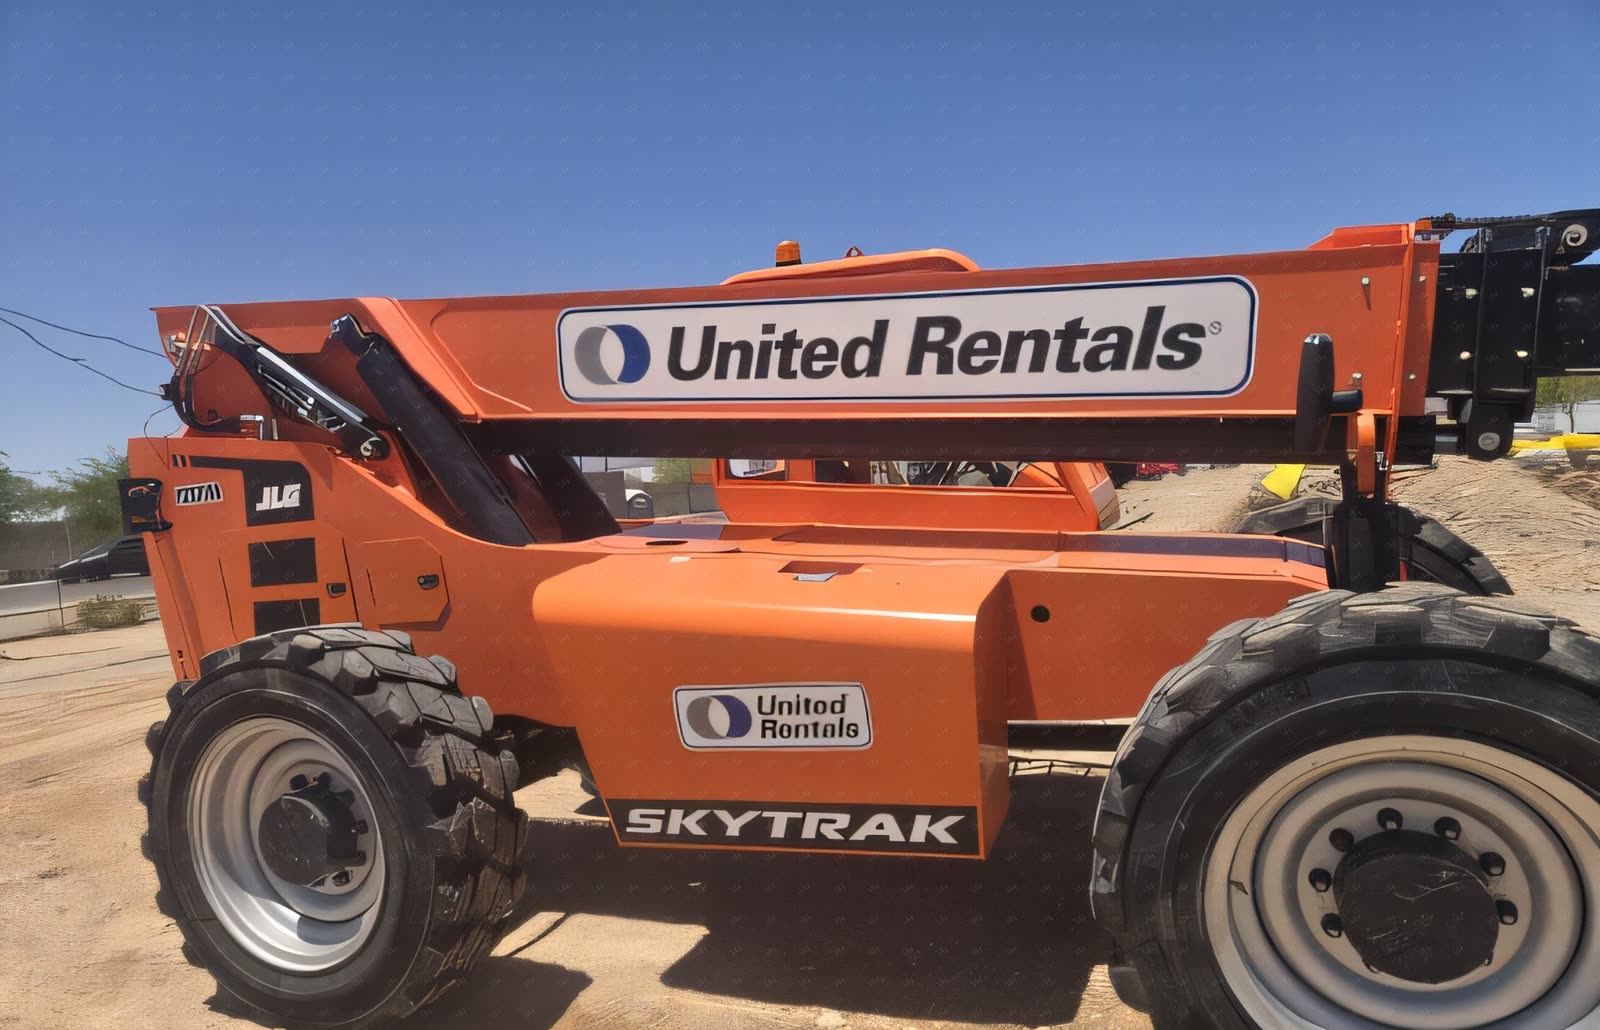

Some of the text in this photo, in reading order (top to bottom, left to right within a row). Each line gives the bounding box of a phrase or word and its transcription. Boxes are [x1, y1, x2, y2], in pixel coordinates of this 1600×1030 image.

[667, 305, 1203, 381] United Rentals
[255, 483, 301, 511] JLG
[626, 808, 965, 844] SKYTRAK
